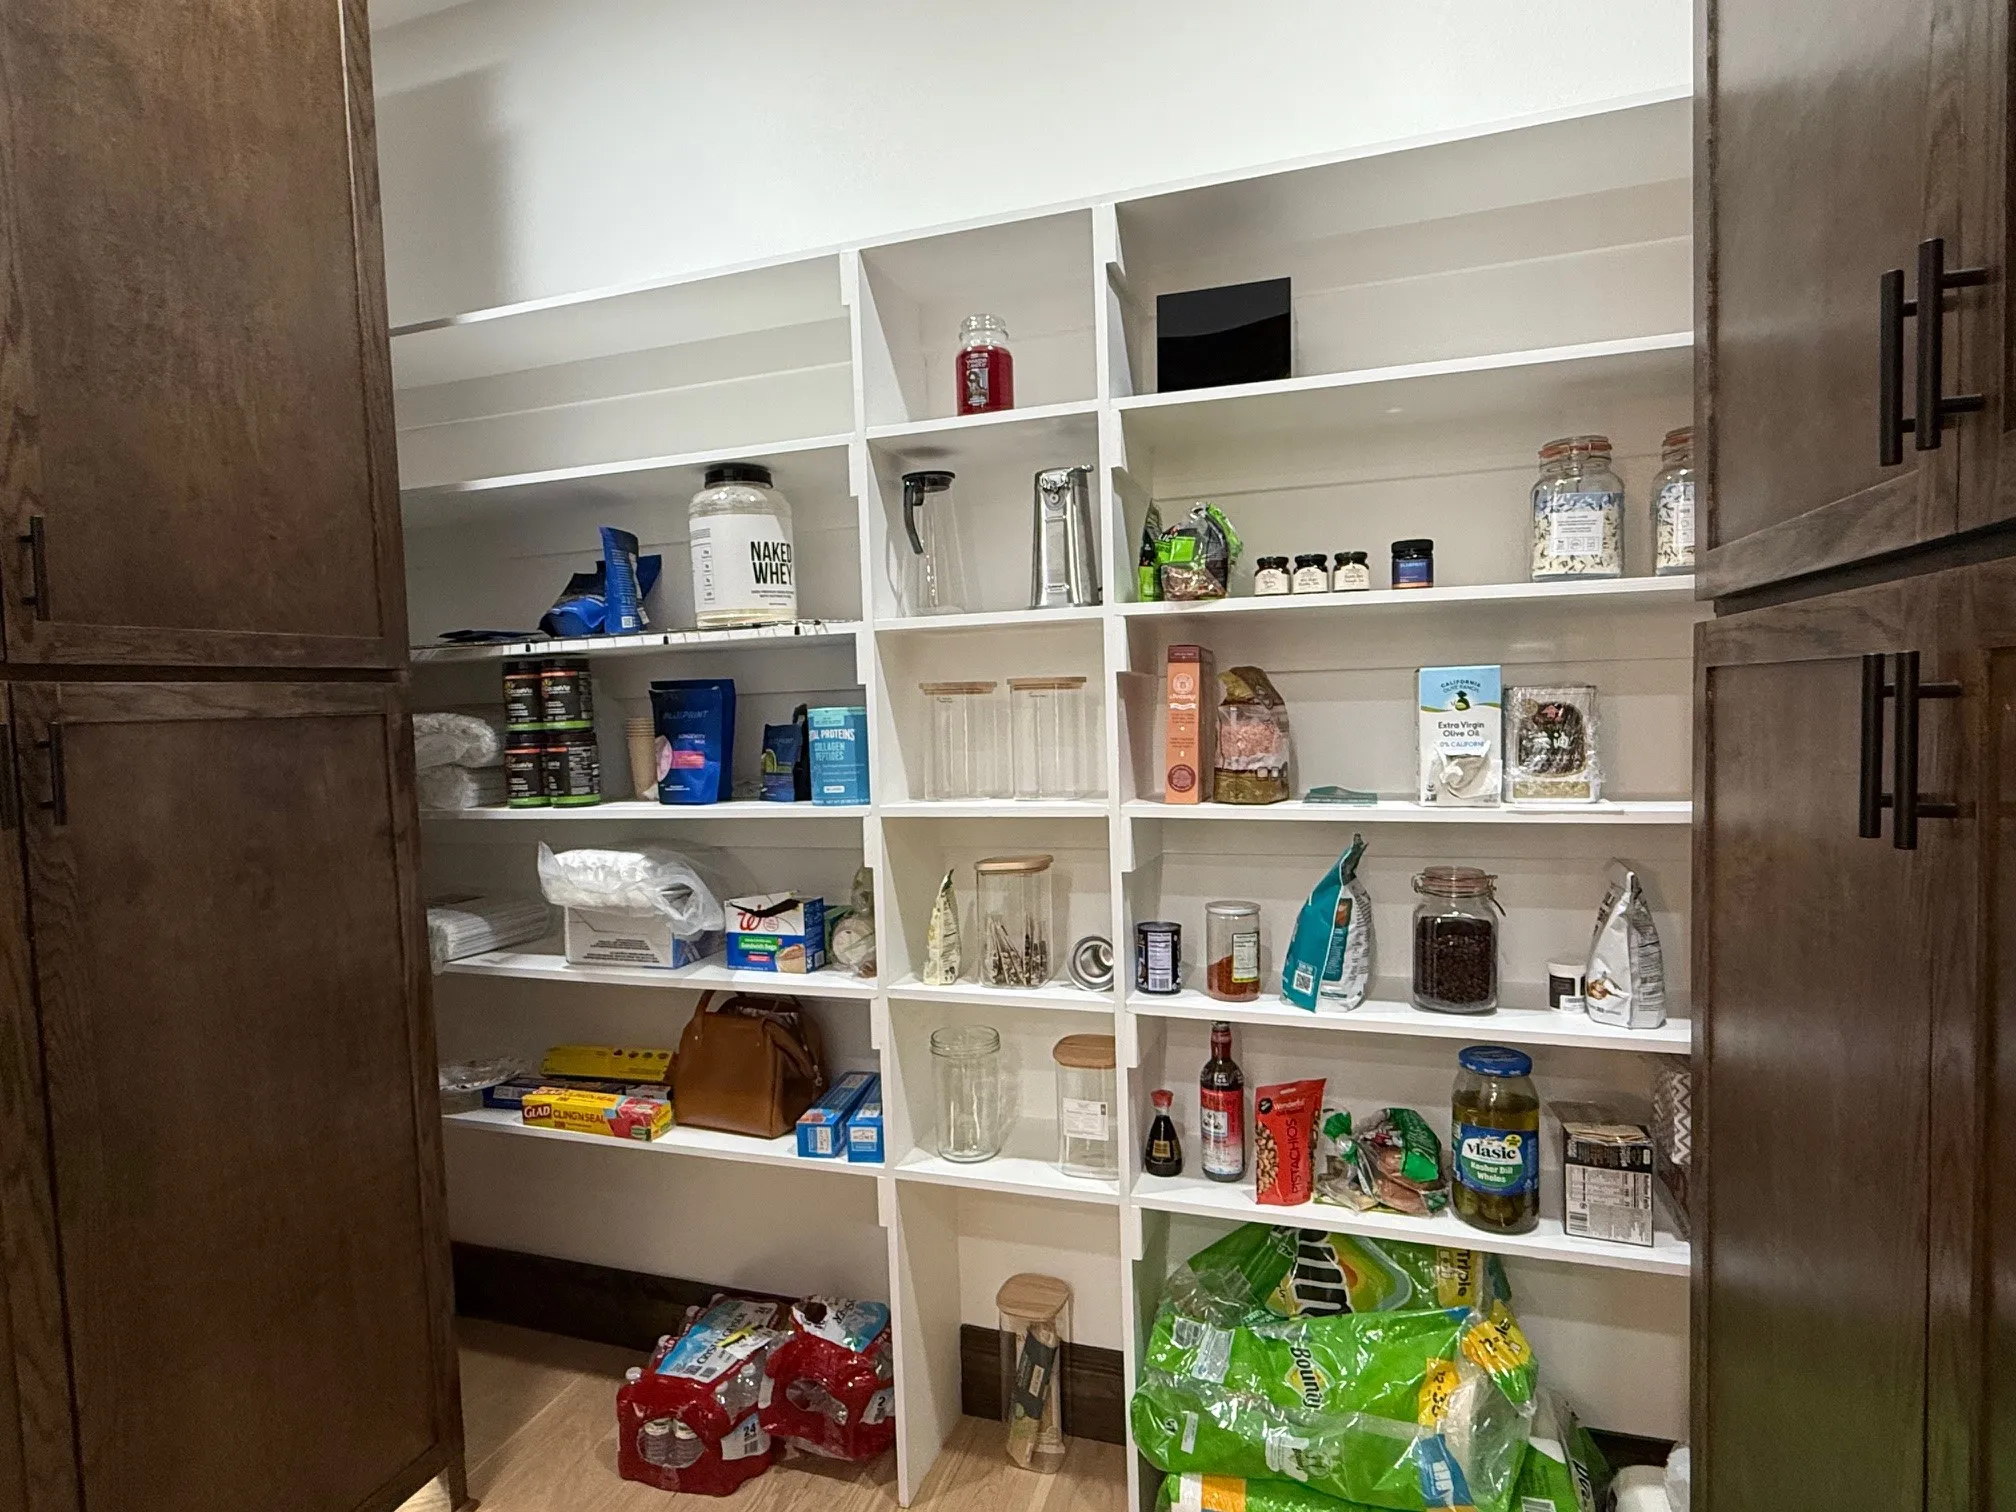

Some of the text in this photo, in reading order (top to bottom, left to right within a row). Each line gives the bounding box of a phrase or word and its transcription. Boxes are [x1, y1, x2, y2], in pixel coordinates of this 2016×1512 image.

[750, 541, 793, 563] NAKED
[752, 562, 793, 586] WHEY
[1461, 721, 1484, 730] Virgin
[820, 728, 856, 742] PROTEINS
[814, 741, 846, 752] COLLAGEN
[815, 751, 845, 761] PEPTIDES
[523, 1105, 551, 1119] GLAD
[585, 1112, 606, 1124] SEAL
[1285, 1117, 1302, 1194] PISTACHIOS
[1466, 1142, 1517, 1160] Vlasic
[1470, 1161, 1514, 1175] Kosher Dill
[1476, 1171, 1507, 1184] Wholes
[1457, 1249, 1472, 1297] Triple
[1290, 1347, 1322, 1408] Bounty
